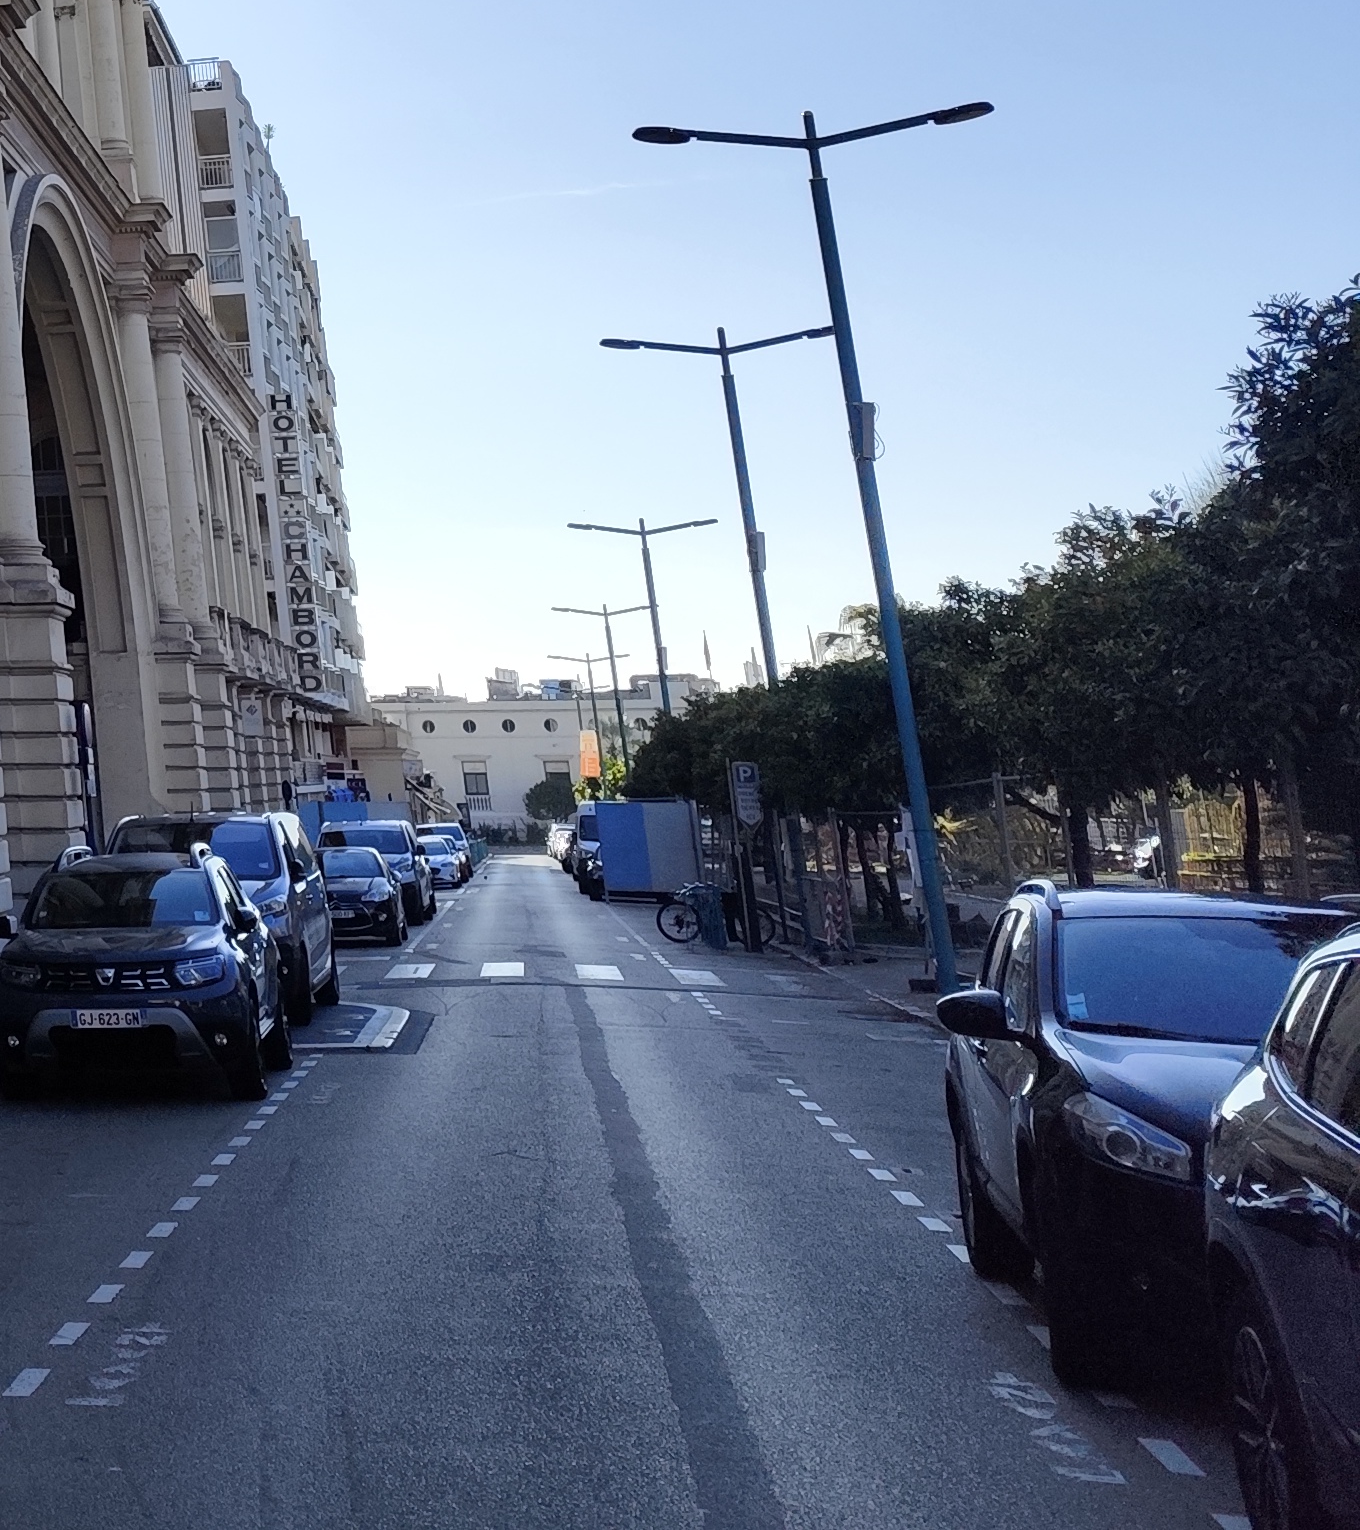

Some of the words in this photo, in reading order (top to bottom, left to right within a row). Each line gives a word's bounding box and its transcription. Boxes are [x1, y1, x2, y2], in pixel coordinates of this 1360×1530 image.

[269, 393, 302, 495] HOTEL
[283, 521, 322, 692] CHAMBORD
[738, 766, 752, 782] P
[78, 1012, 140, 1026] GJ-623-GN
